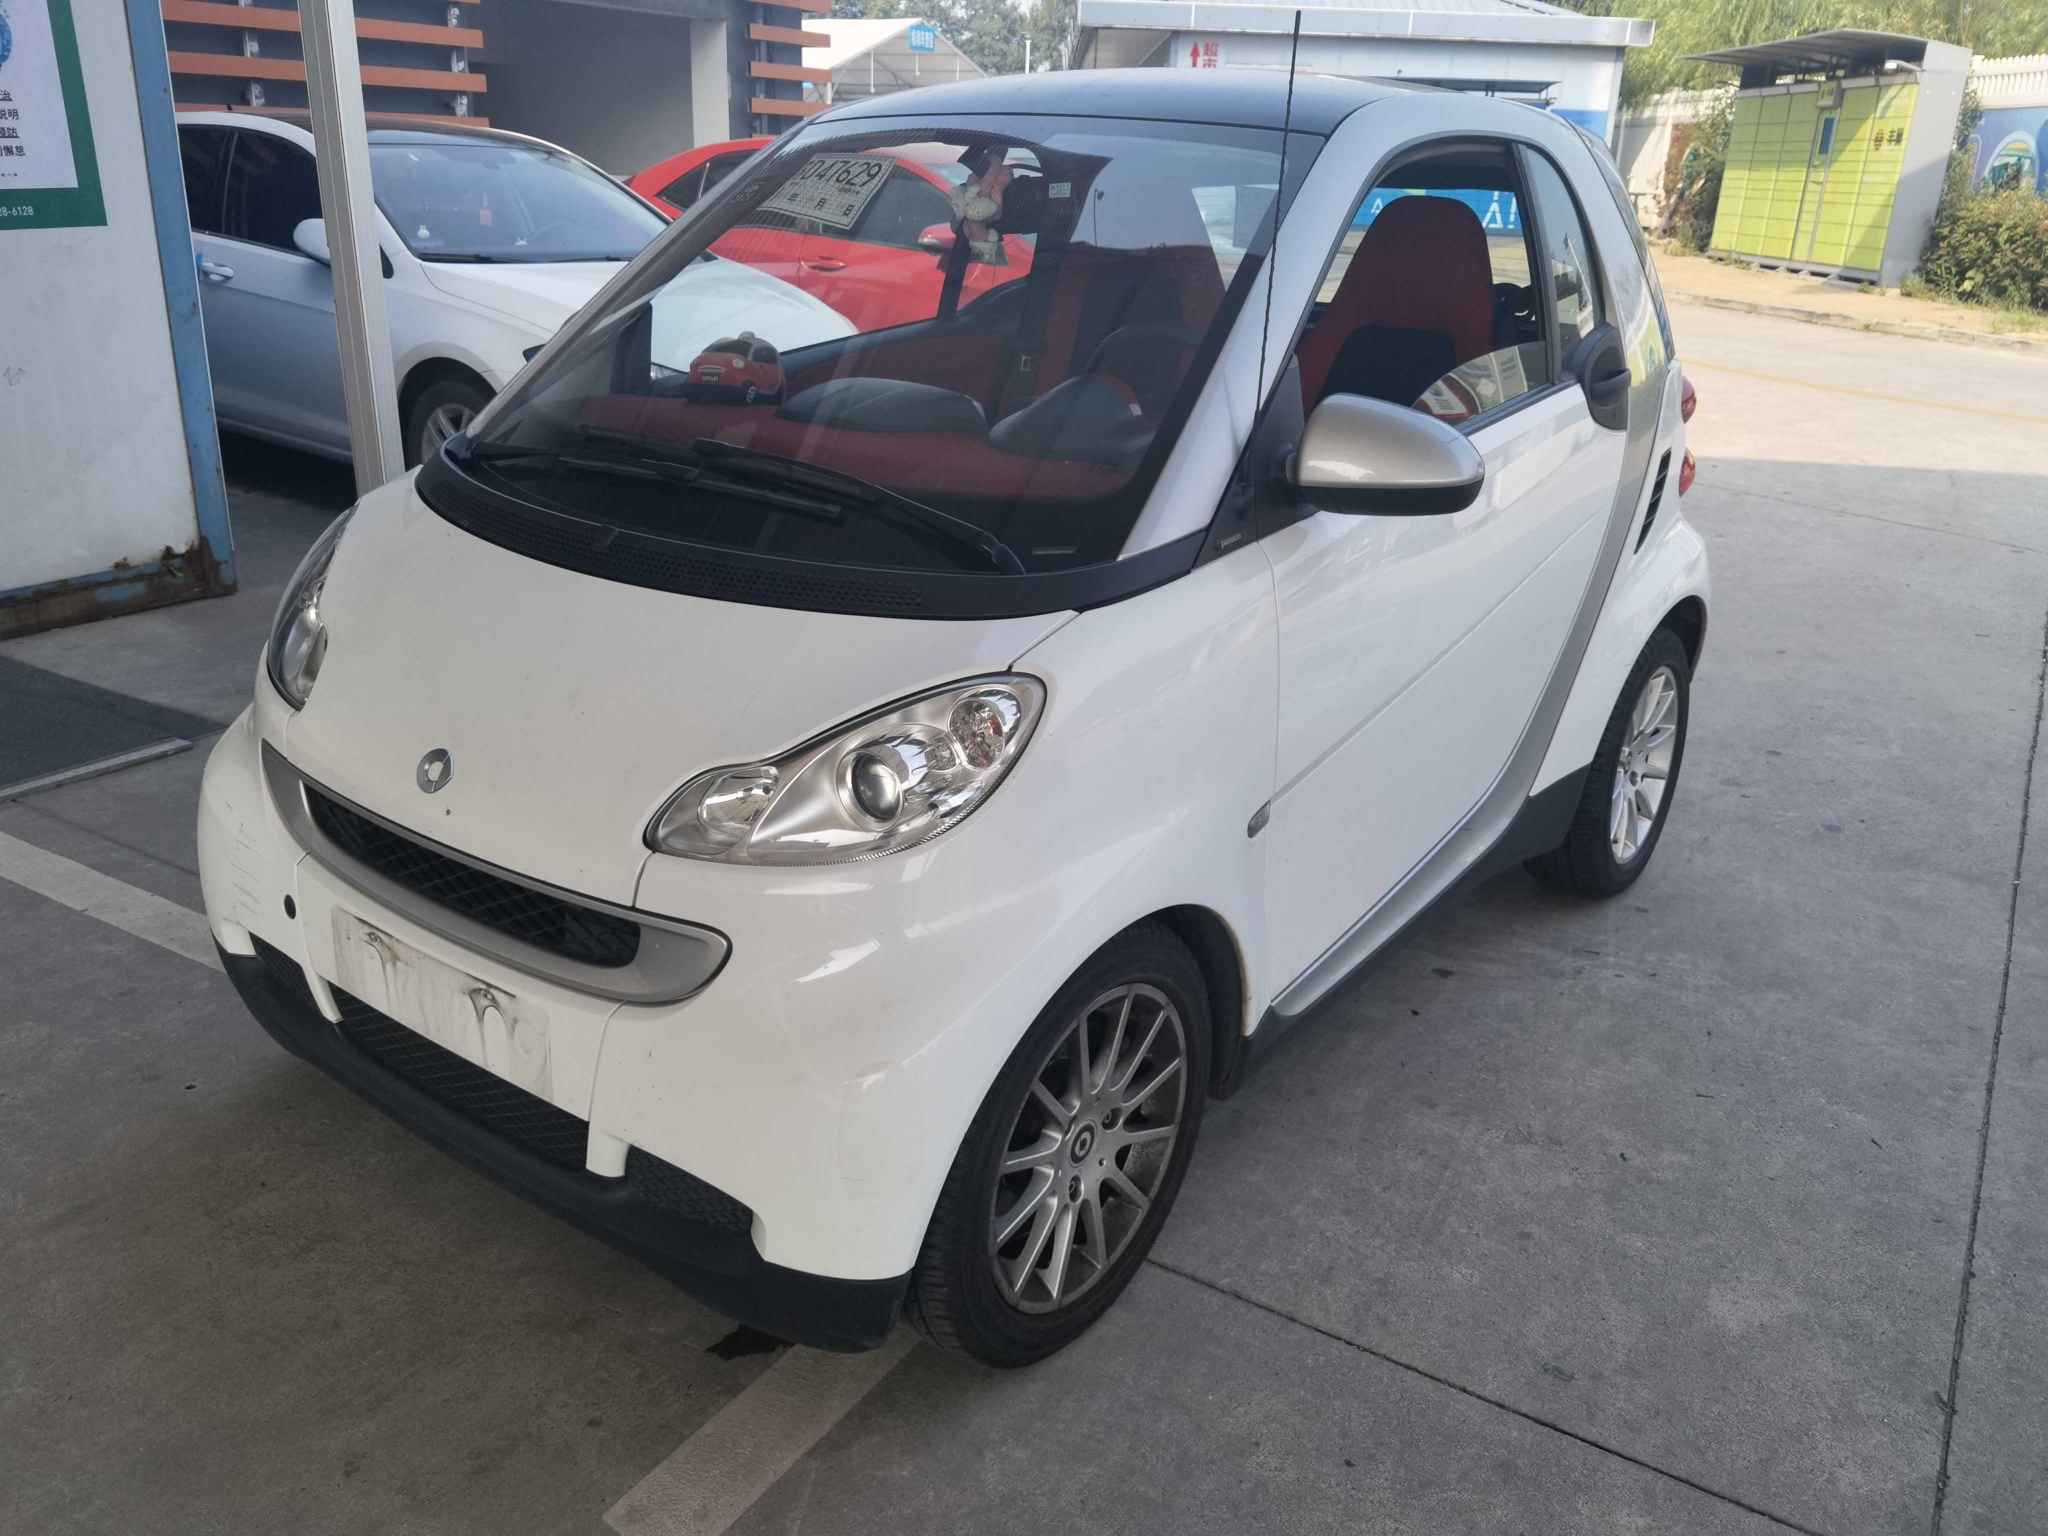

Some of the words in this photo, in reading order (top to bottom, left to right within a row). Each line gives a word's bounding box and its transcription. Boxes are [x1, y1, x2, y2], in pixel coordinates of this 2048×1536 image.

[0, 145, 26, 156] 懈怠
[814, 198, 827, 210] 月
[843, 204, 855, 217] 日
[1221, 533, 1242, 549] passion
